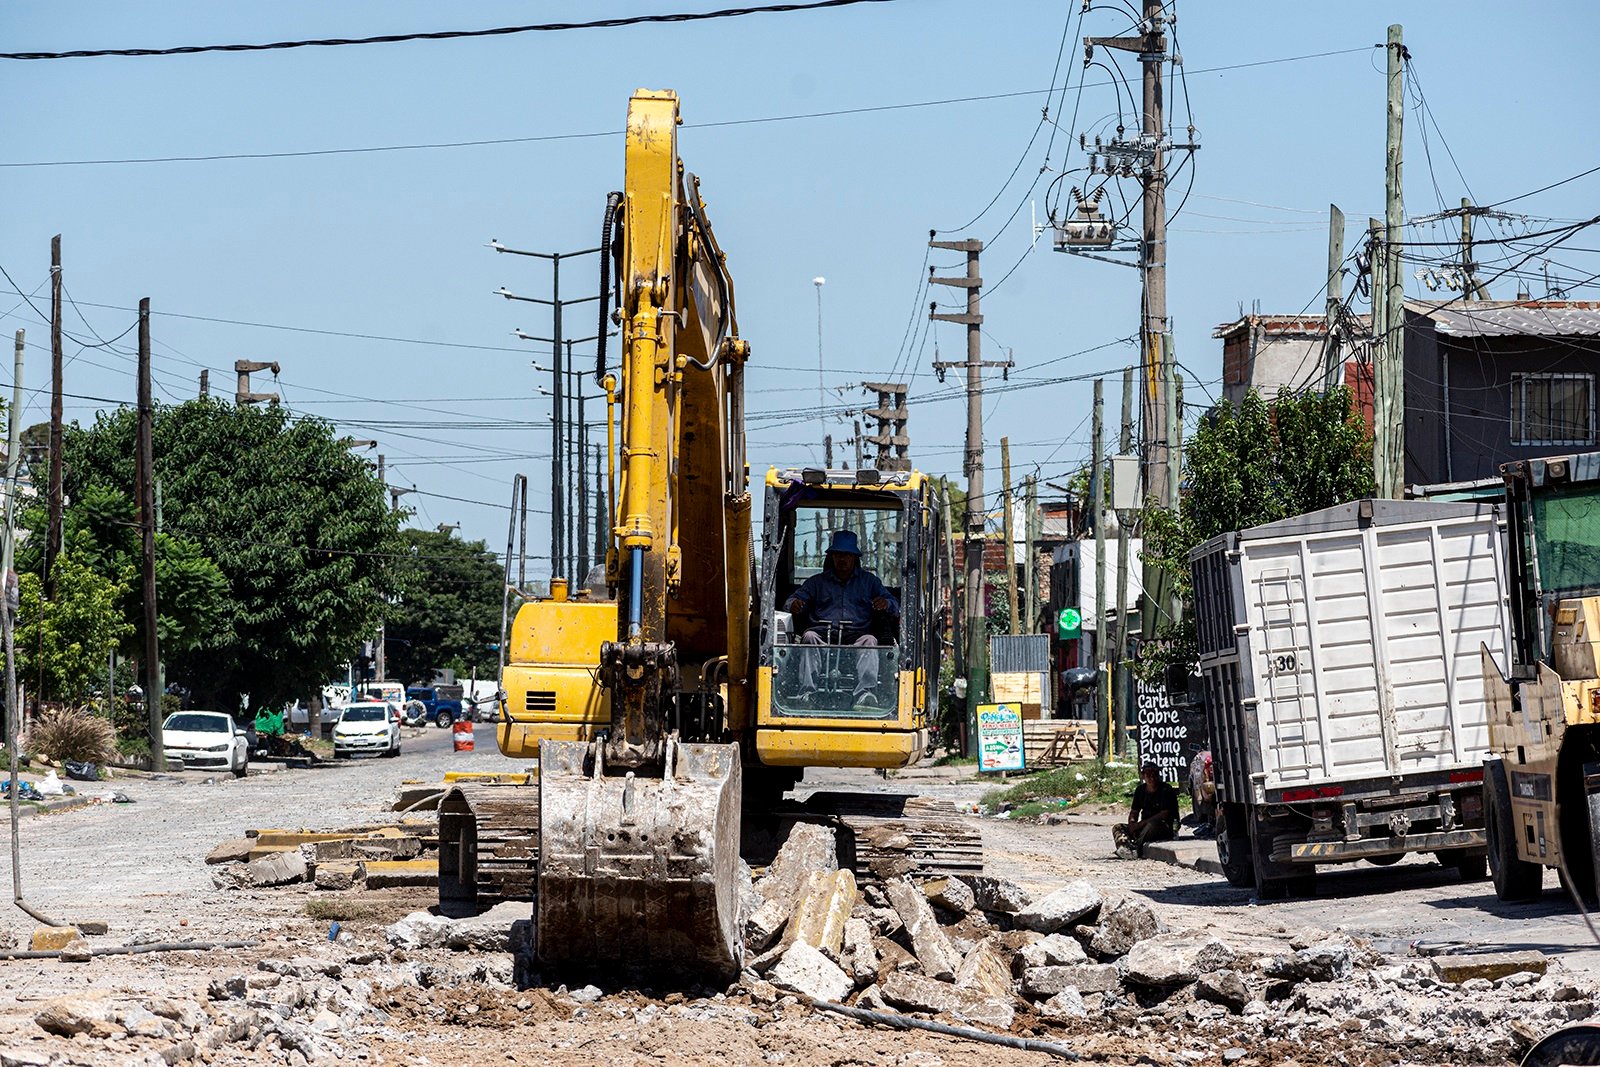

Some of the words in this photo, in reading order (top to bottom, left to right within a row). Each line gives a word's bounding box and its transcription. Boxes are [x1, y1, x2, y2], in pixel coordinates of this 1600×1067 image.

[1277, 655, 1295, 671] 30
[1138, 707, 1180, 724] Cobre
[1140, 725, 1187, 740] Bronce
[1140, 739, 1181, 754] Plomo
